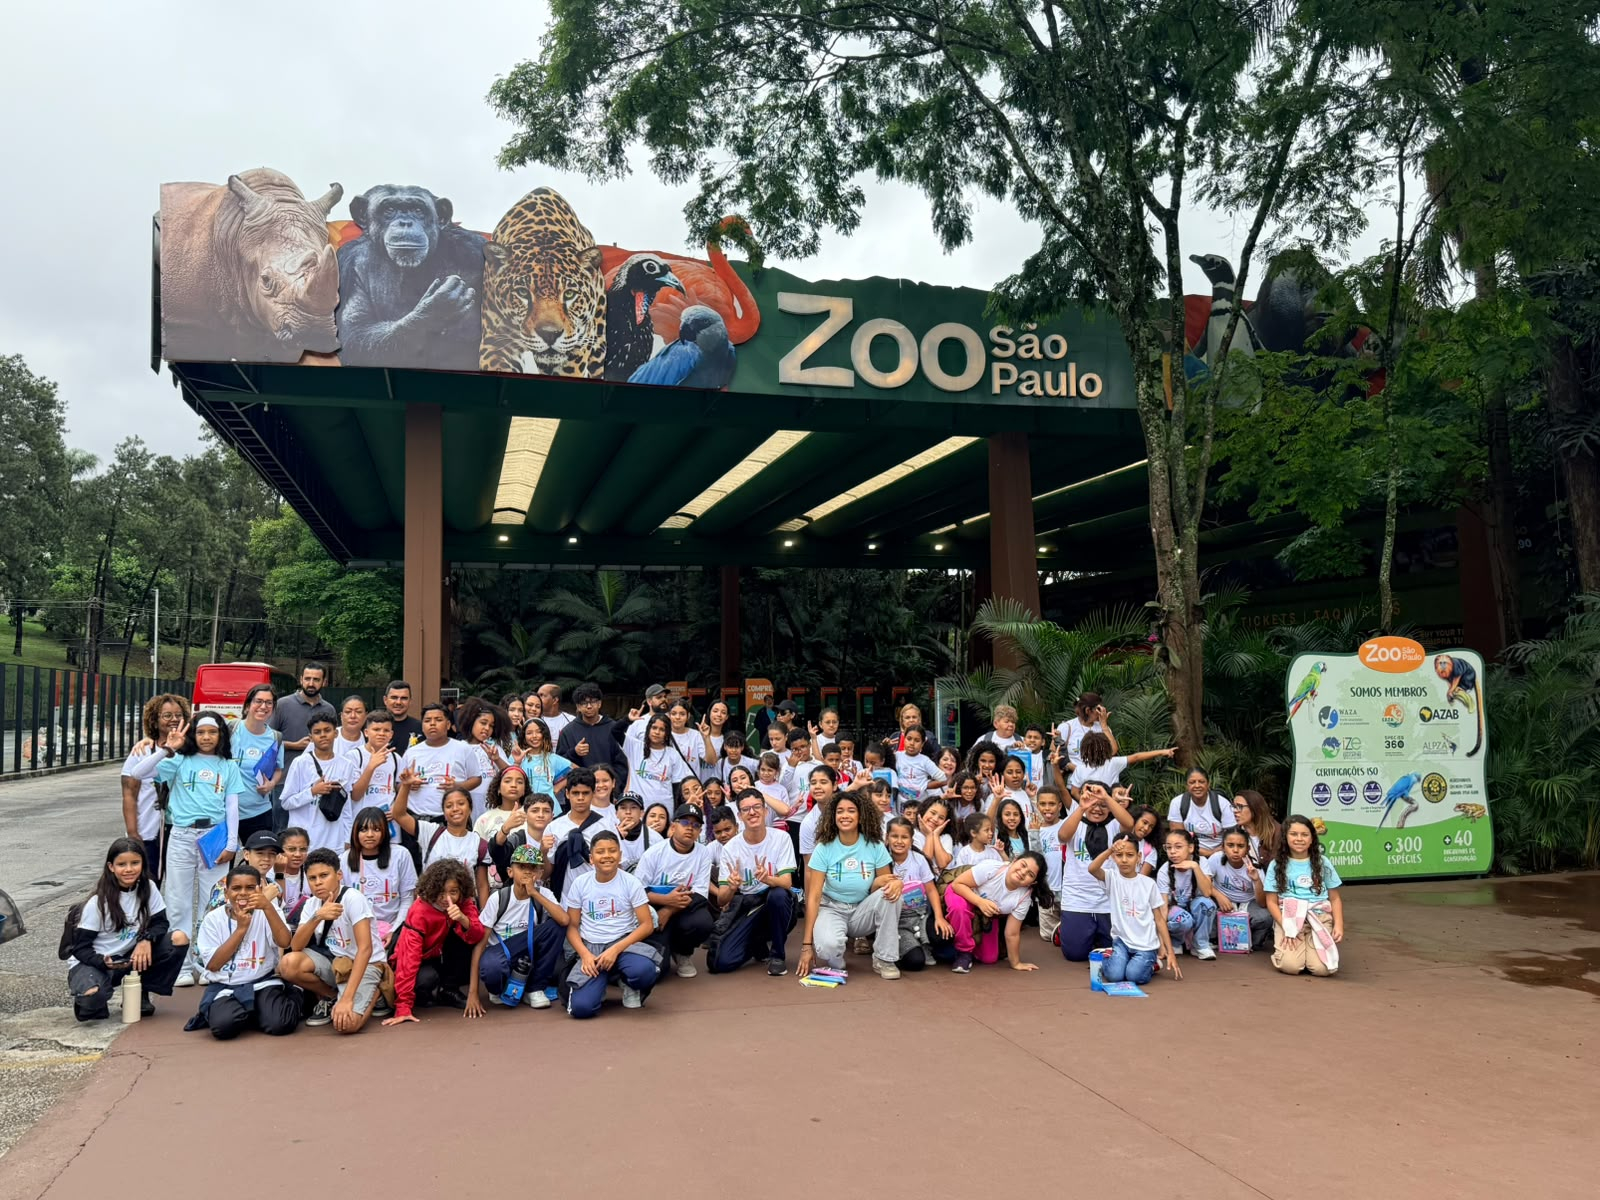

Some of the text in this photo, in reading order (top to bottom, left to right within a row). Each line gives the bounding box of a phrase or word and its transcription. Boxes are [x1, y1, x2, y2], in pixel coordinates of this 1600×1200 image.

[777, 291, 987, 393] Zoo
[989, 323, 1069, 362] São
[991, 361, 1103, 398] Paulo
[1365, 644, 1402, 662] Zoo
[1402, 653, 1423, 661] Paulo
[747, 684, 774, 692] COMPRE
[1350, 686, 1428, 698] SOMOS MEMBROS
[1432, 708, 1460, 720] AZAB
[1384, 740, 1405, 749] 360
[1422, 740, 1449, 750] ALPZA
[1315, 765, 1379, 777] CERTIFICAÇÕES ISO
[1395, 836, 1423, 852] 300
[1454, 830, 1473, 846] 40
[1329, 839, 1363, 854] 2.200
[1329, 855, 1364, 866] ANIMAIS
[1387, 852, 1423, 865] ESPÉCIES
